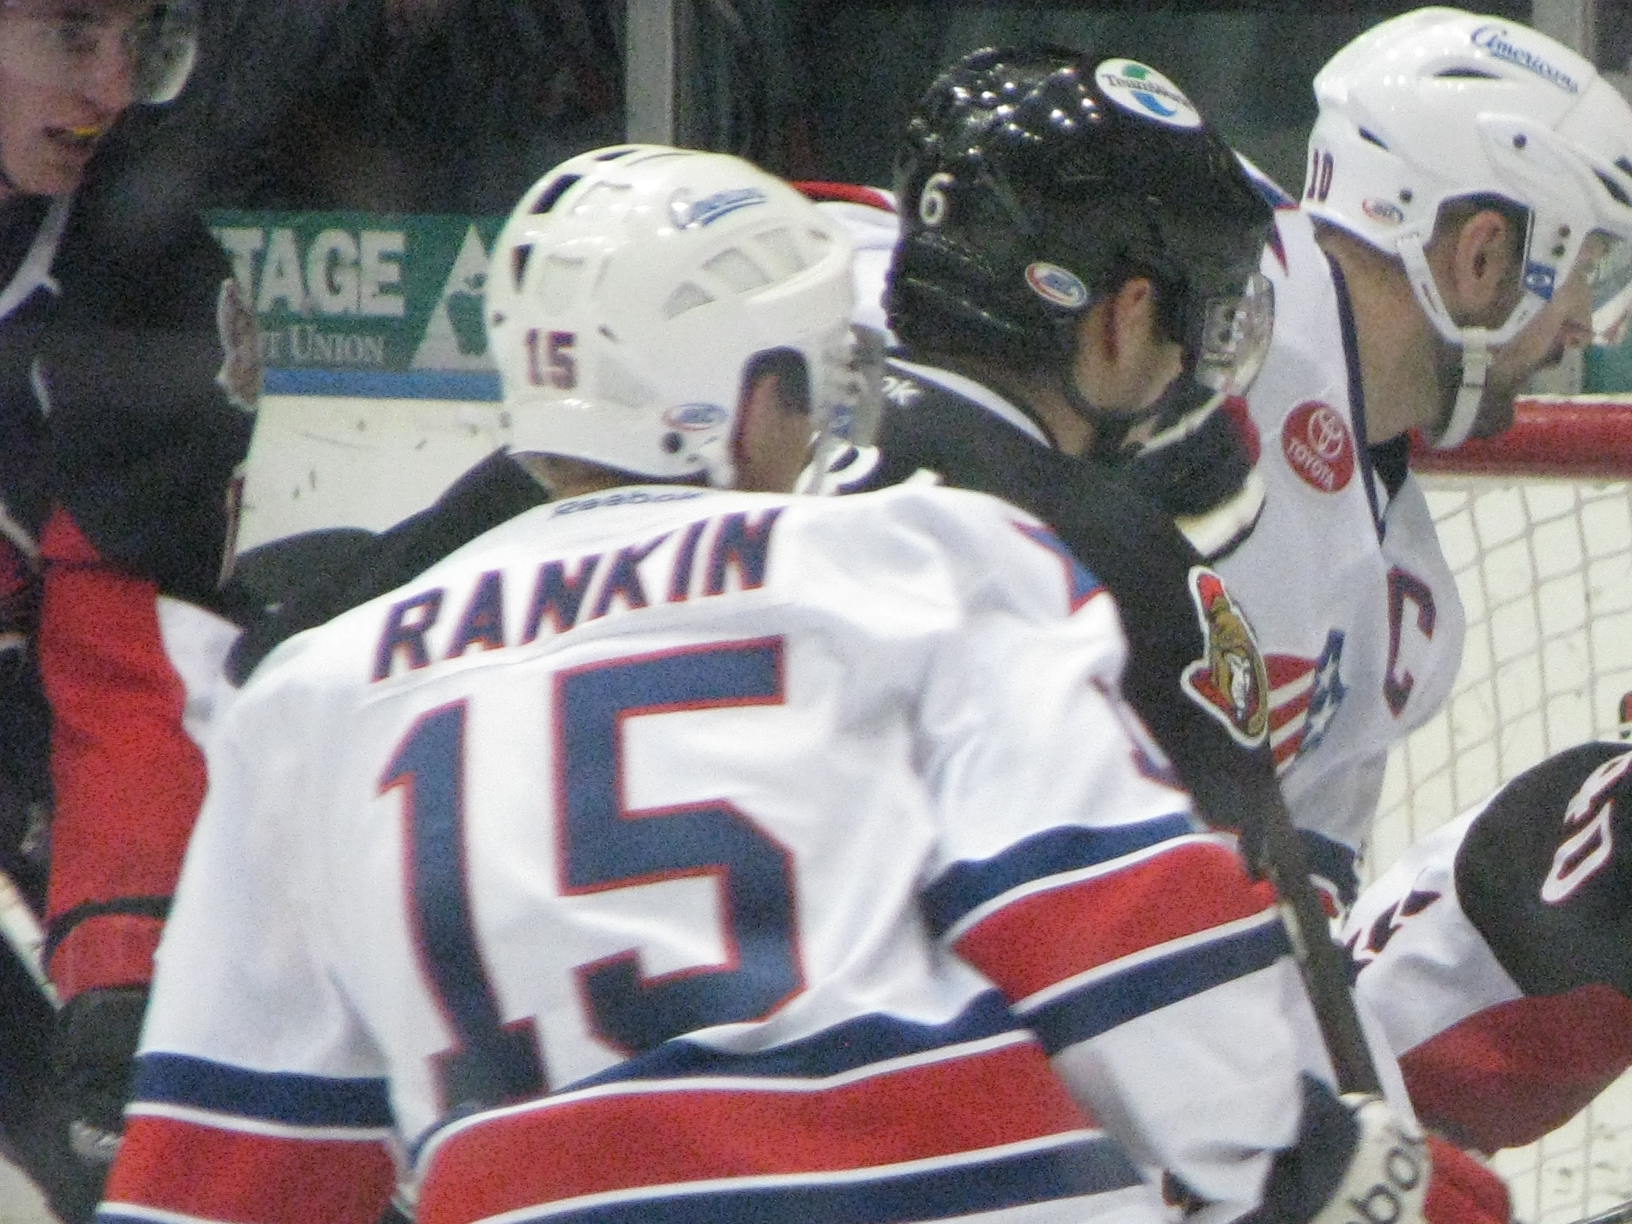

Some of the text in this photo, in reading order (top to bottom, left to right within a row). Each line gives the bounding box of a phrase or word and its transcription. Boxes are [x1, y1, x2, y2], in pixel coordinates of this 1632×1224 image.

[918, 172, 956, 227] 6
[525, 327, 579, 391] 15
[1288, 437, 1337, 491] TOYOTA
[371, 505, 790, 684] RANKIN
[378, 633, 807, 1118] 15
